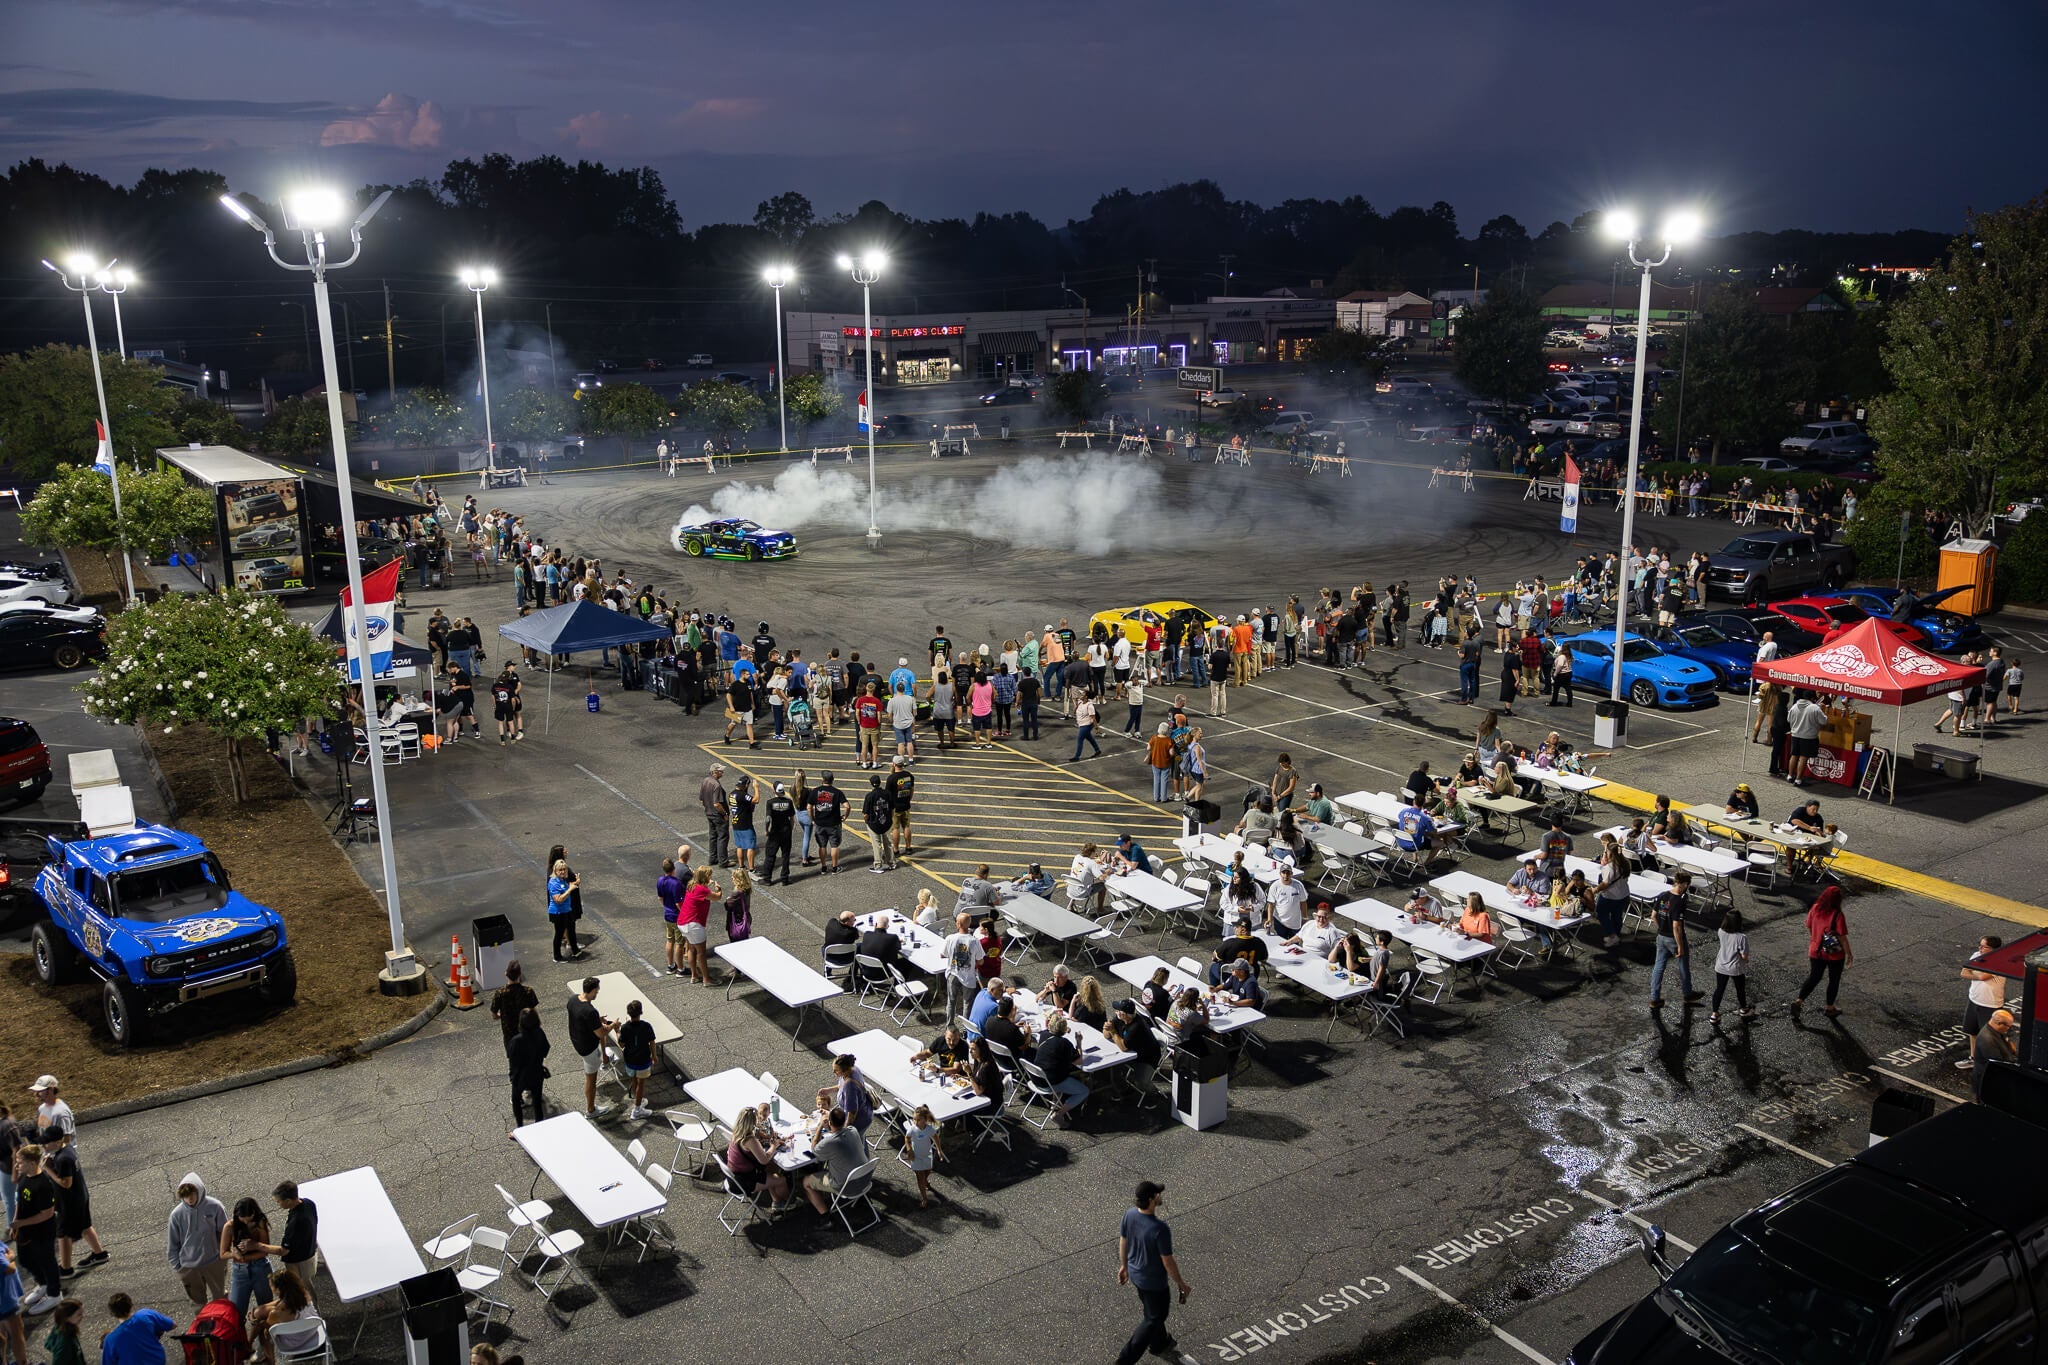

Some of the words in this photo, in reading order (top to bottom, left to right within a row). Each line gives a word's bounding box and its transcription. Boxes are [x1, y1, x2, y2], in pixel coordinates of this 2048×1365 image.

[931, 326, 964, 336] CLOSET
[1180, 370, 1211, 383] Cheddar's
[1813, 652, 1875, 675] CAVENDISH
[1768, 669, 1808, 684] Cavendish
[1809, 676, 1843, 692] Brewery
[1843, 682, 1883, 700] Company
[1878, 1024, 1972, 1068] USTOMER
[1414, 1197, 1575, 1270] CUSTOMER
[1207, 1276, 1391, 1362] CUSTOMER
